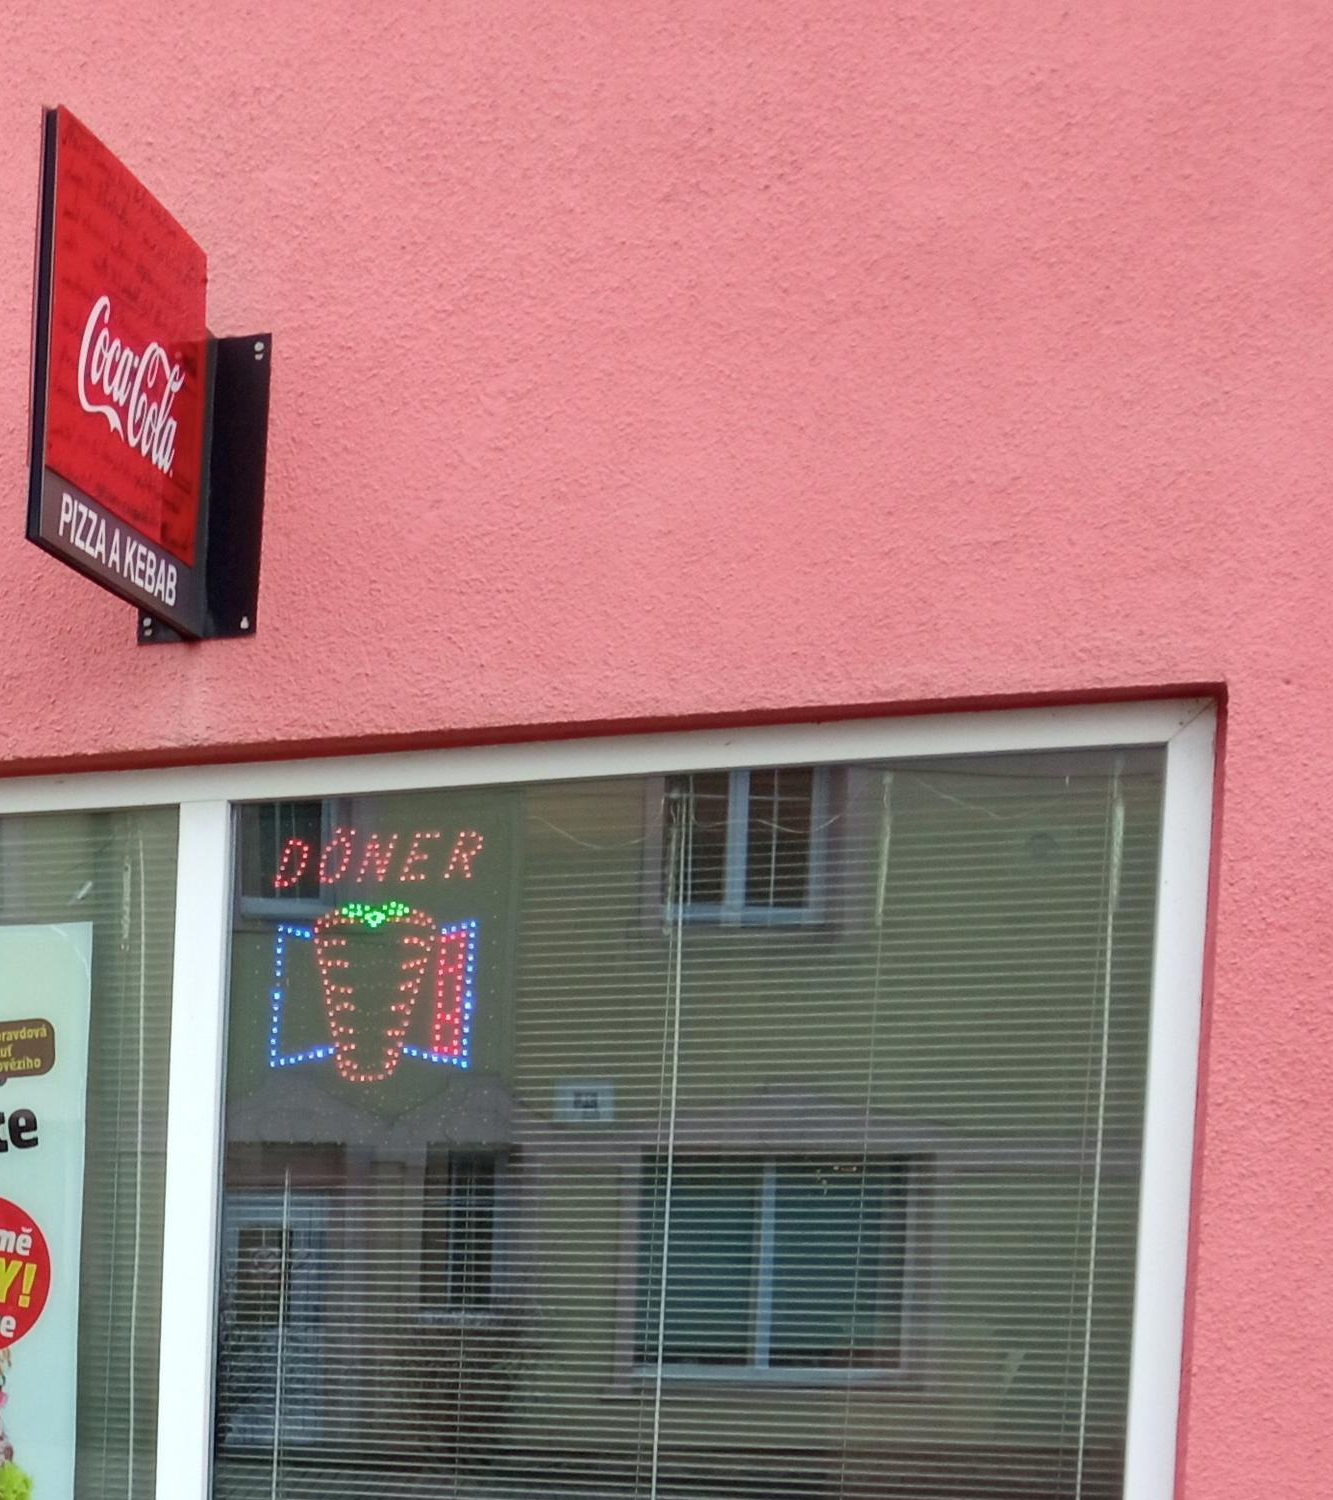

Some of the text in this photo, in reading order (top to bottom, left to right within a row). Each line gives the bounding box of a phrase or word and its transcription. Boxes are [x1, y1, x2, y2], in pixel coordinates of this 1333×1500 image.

[78, 296, 185, 477] Coca-Cola
[59, 492, 178, 607] PIZZA A KEBAB
[273, 828, 485, 889] DÖNER
